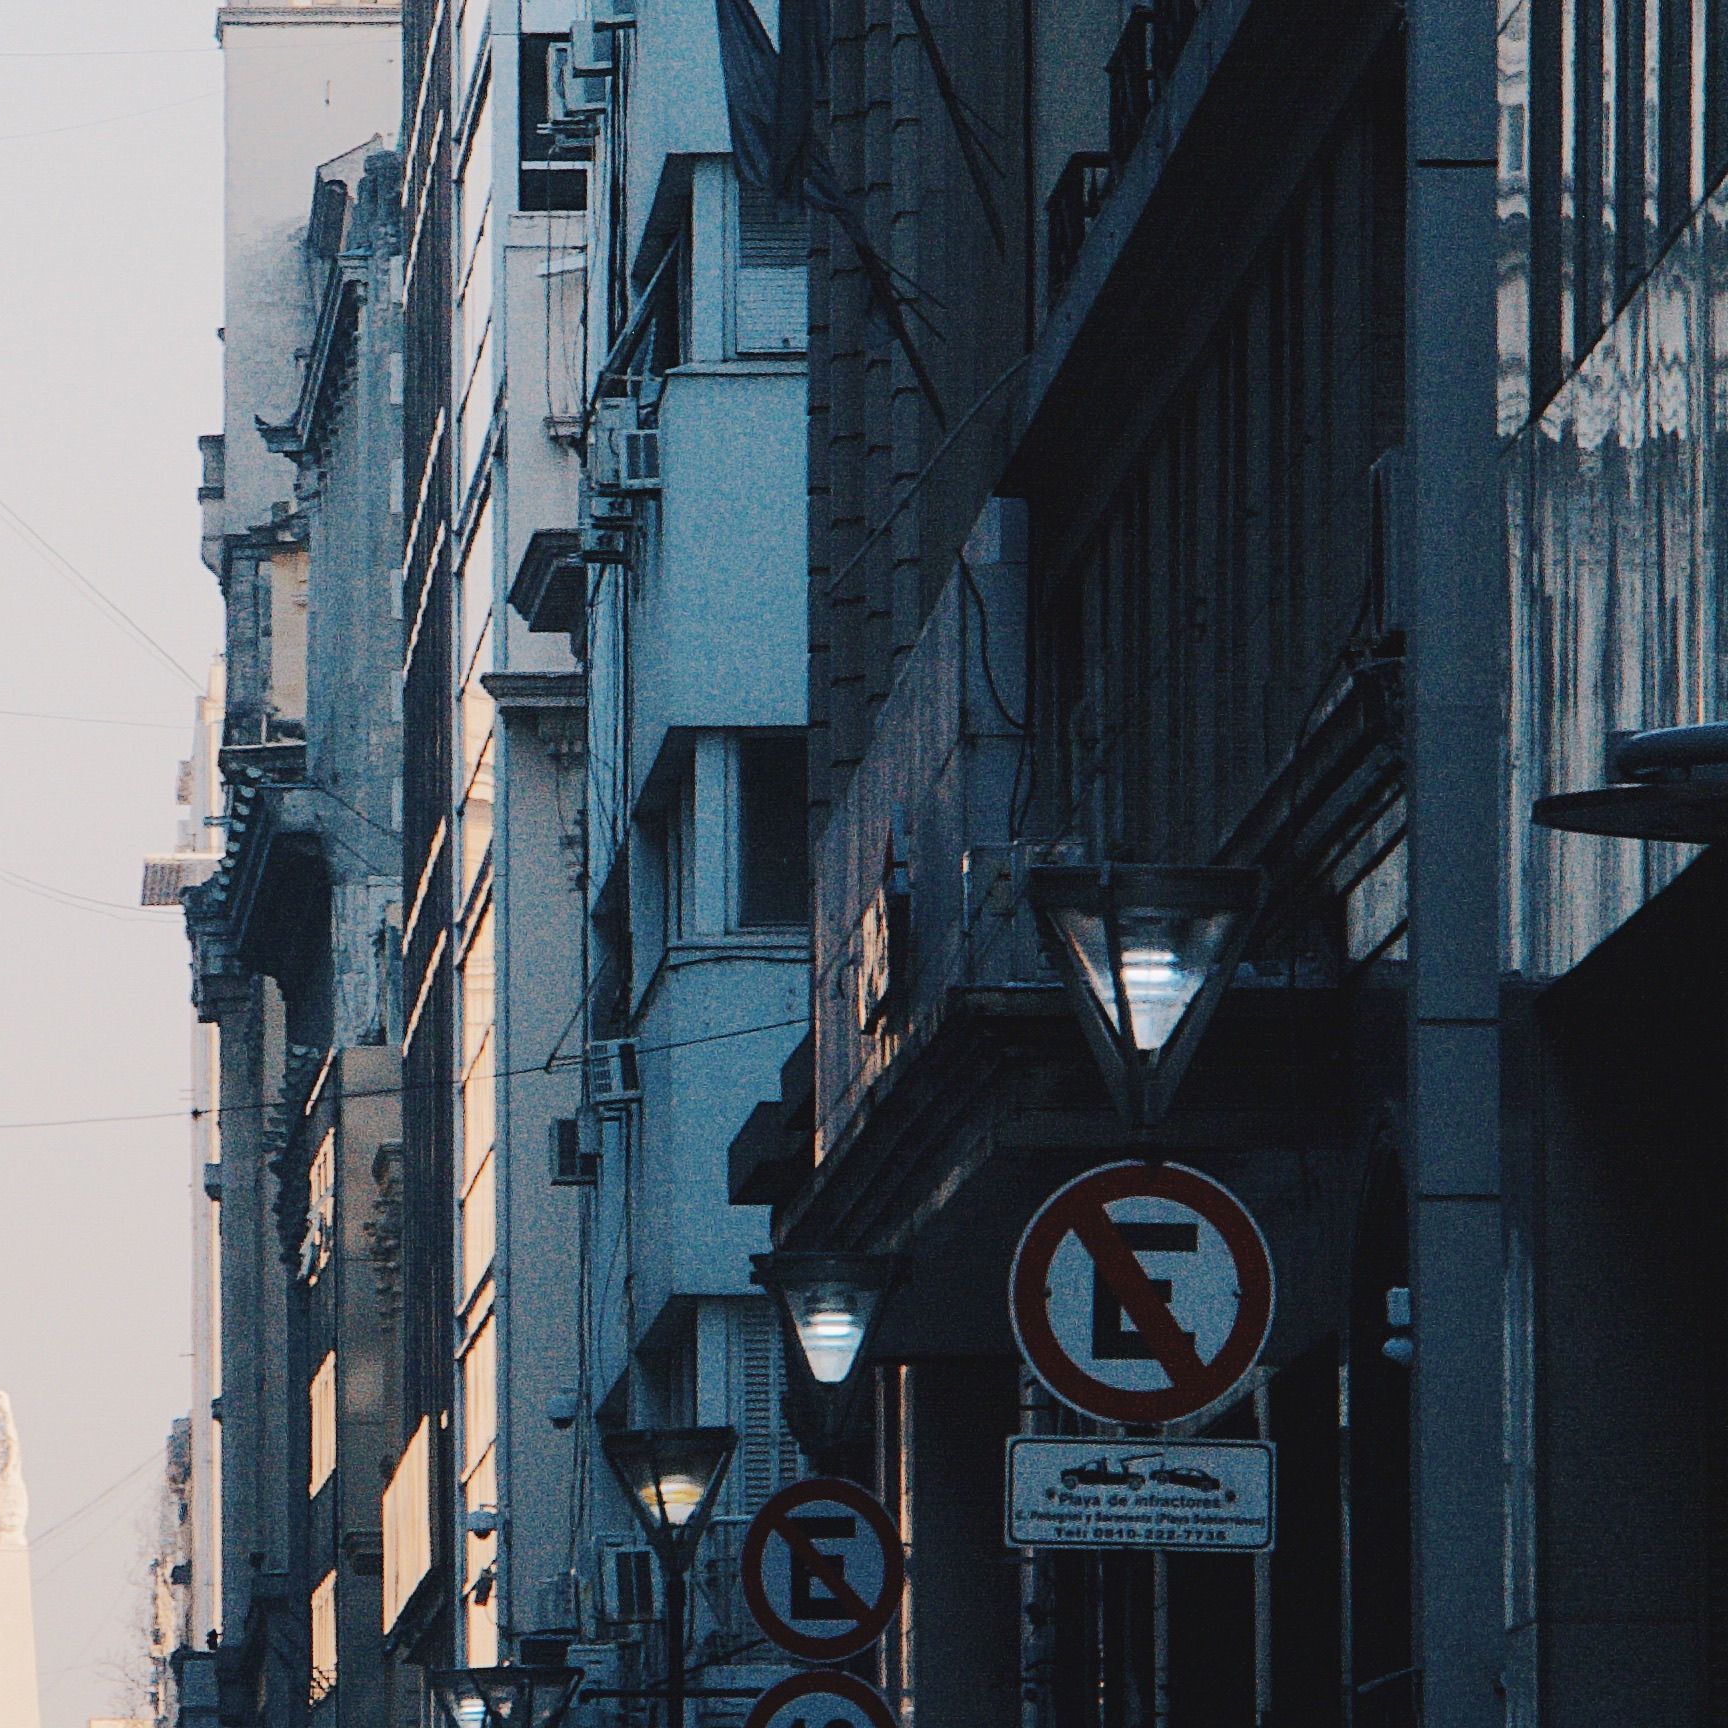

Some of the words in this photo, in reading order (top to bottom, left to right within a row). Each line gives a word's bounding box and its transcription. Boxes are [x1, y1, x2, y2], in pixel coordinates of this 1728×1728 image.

[1058, 1492, 1101, 1508] Playa
[1107, 1494, 1128, 1507] de
[1134, 1495, 1221, 1509] infractores
